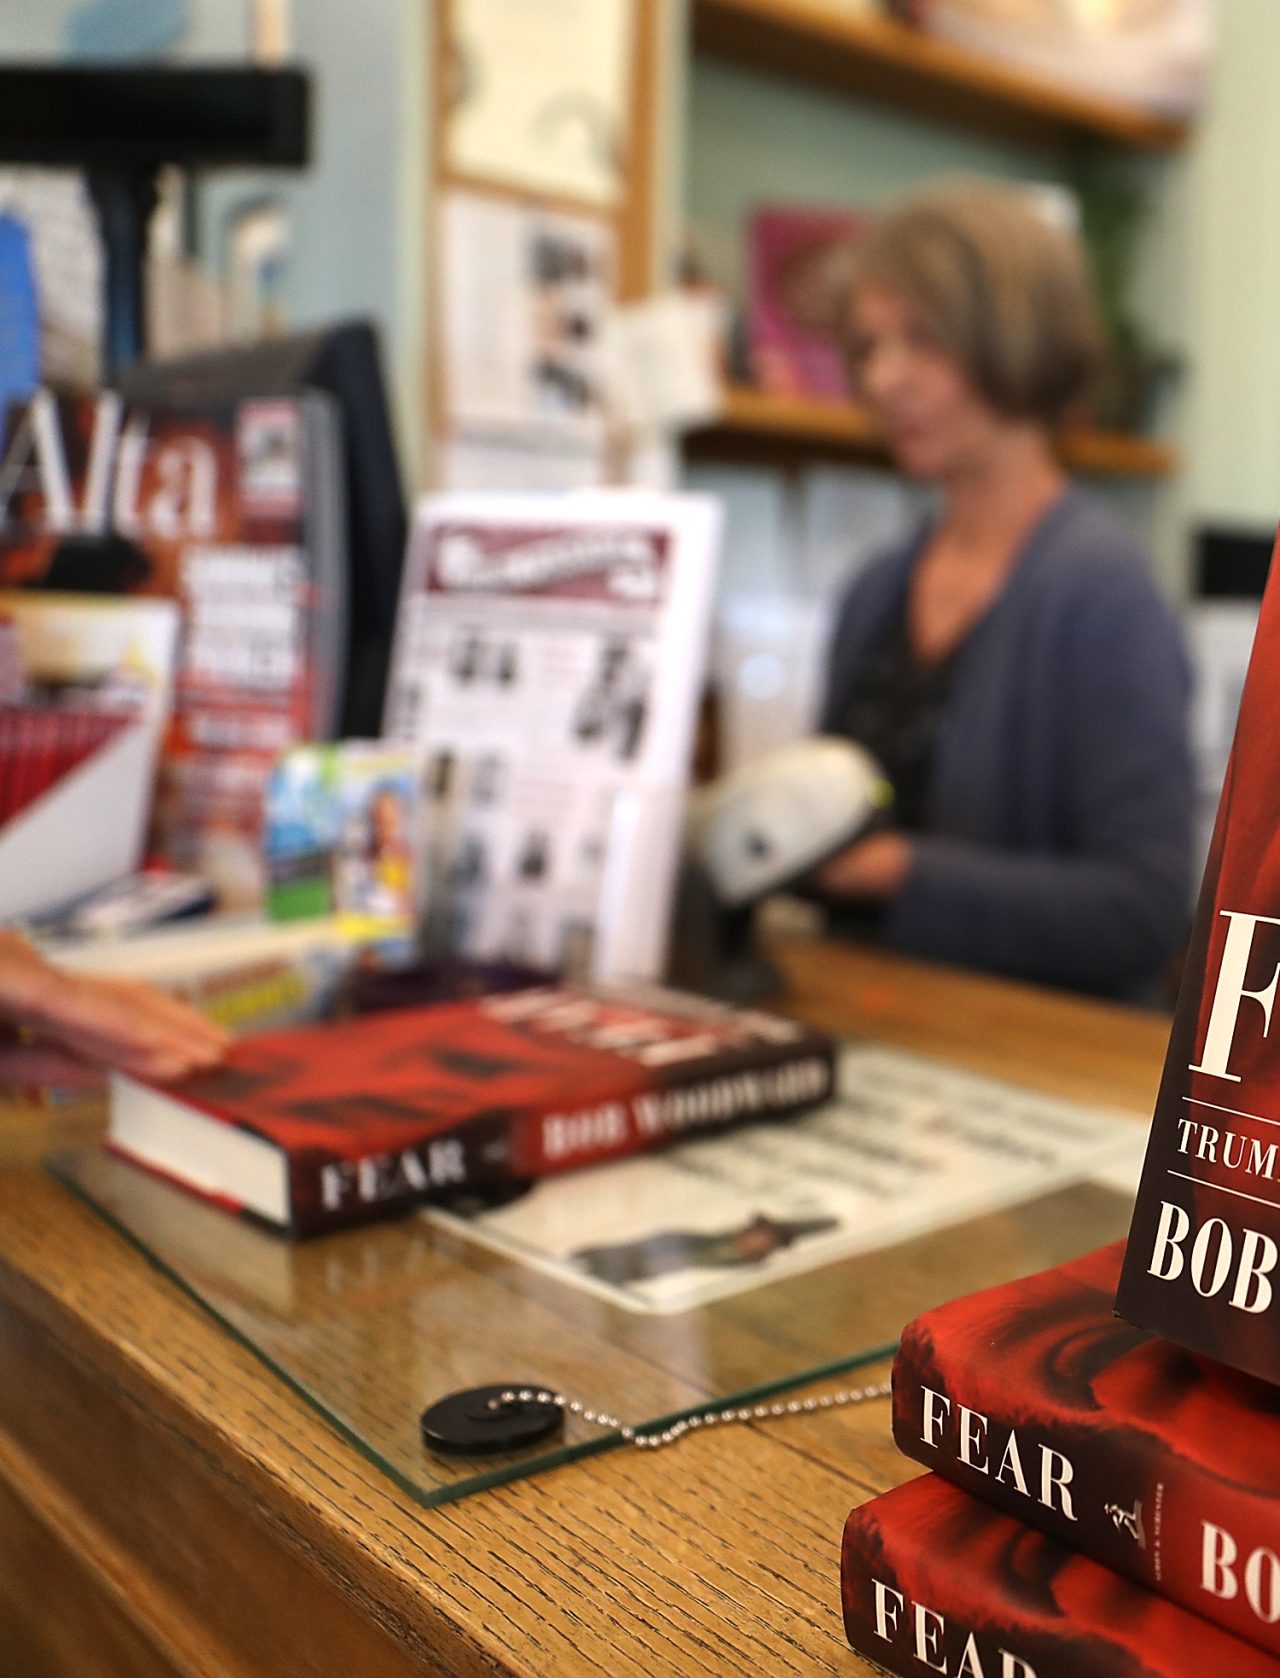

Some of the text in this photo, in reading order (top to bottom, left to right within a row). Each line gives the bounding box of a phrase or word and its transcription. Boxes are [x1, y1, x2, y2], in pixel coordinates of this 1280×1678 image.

[321, 1137, 467, 1212] FEAR
[1147, 1200, 1280, 1315] BOB
[918, 1384, 1079, 1522] FEAR
